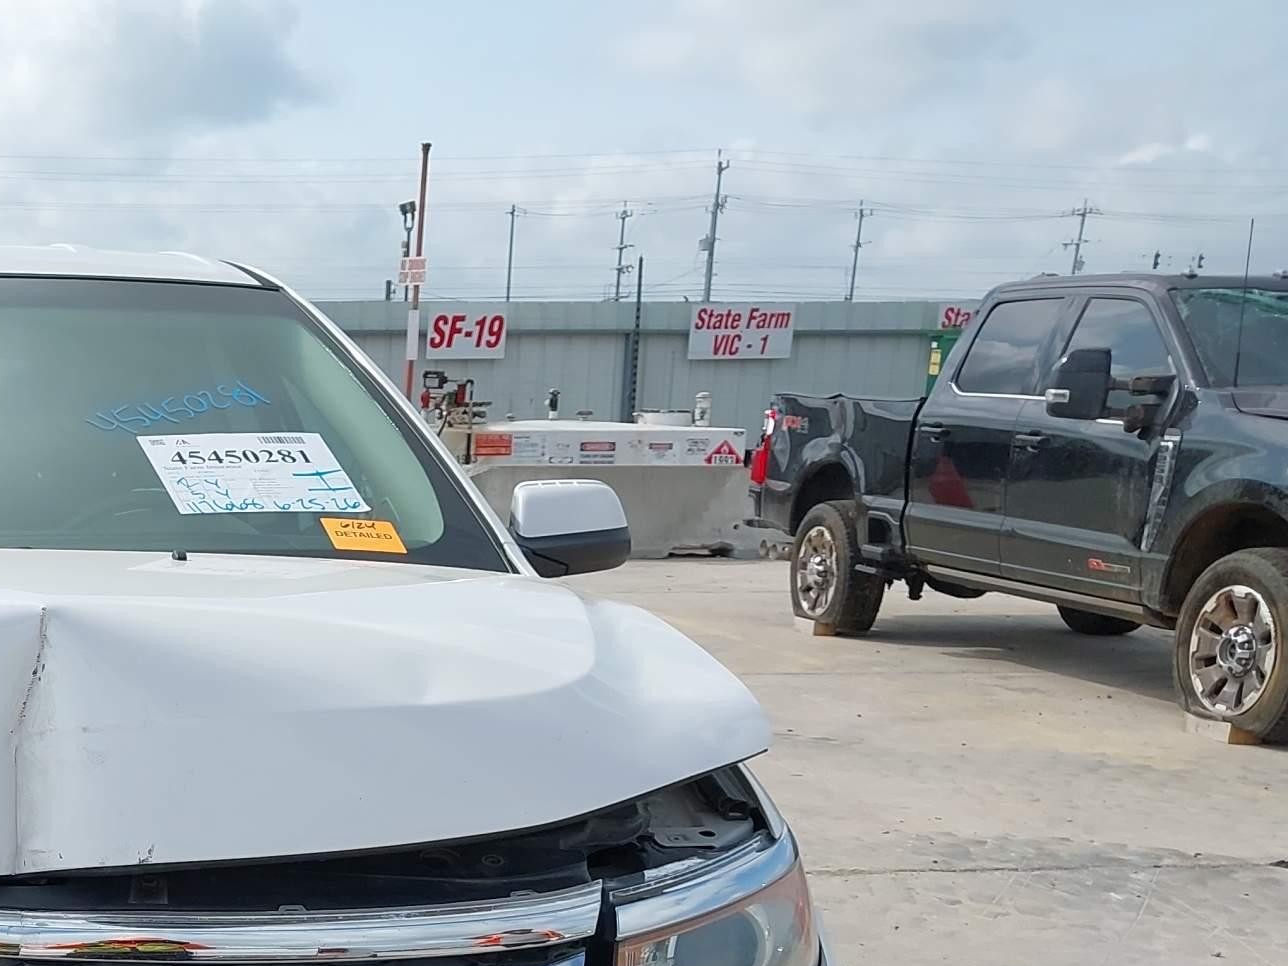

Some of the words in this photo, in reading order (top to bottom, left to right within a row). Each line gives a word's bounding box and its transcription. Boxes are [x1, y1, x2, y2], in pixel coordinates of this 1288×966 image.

[695, 307, 742, 330] State
[745, 307, 791, 329] Farm
[942, 307, 971, 328] Sta
[429, 314, 505, 349] SF-19
[712, 334, 742, 355] VIC
[760, 334, 769, 355] 1
[85, 380, 271, 434] 45450281
[170, 449, 312, 465] 45450281
[335, 530, 393, 540] DETAILED
